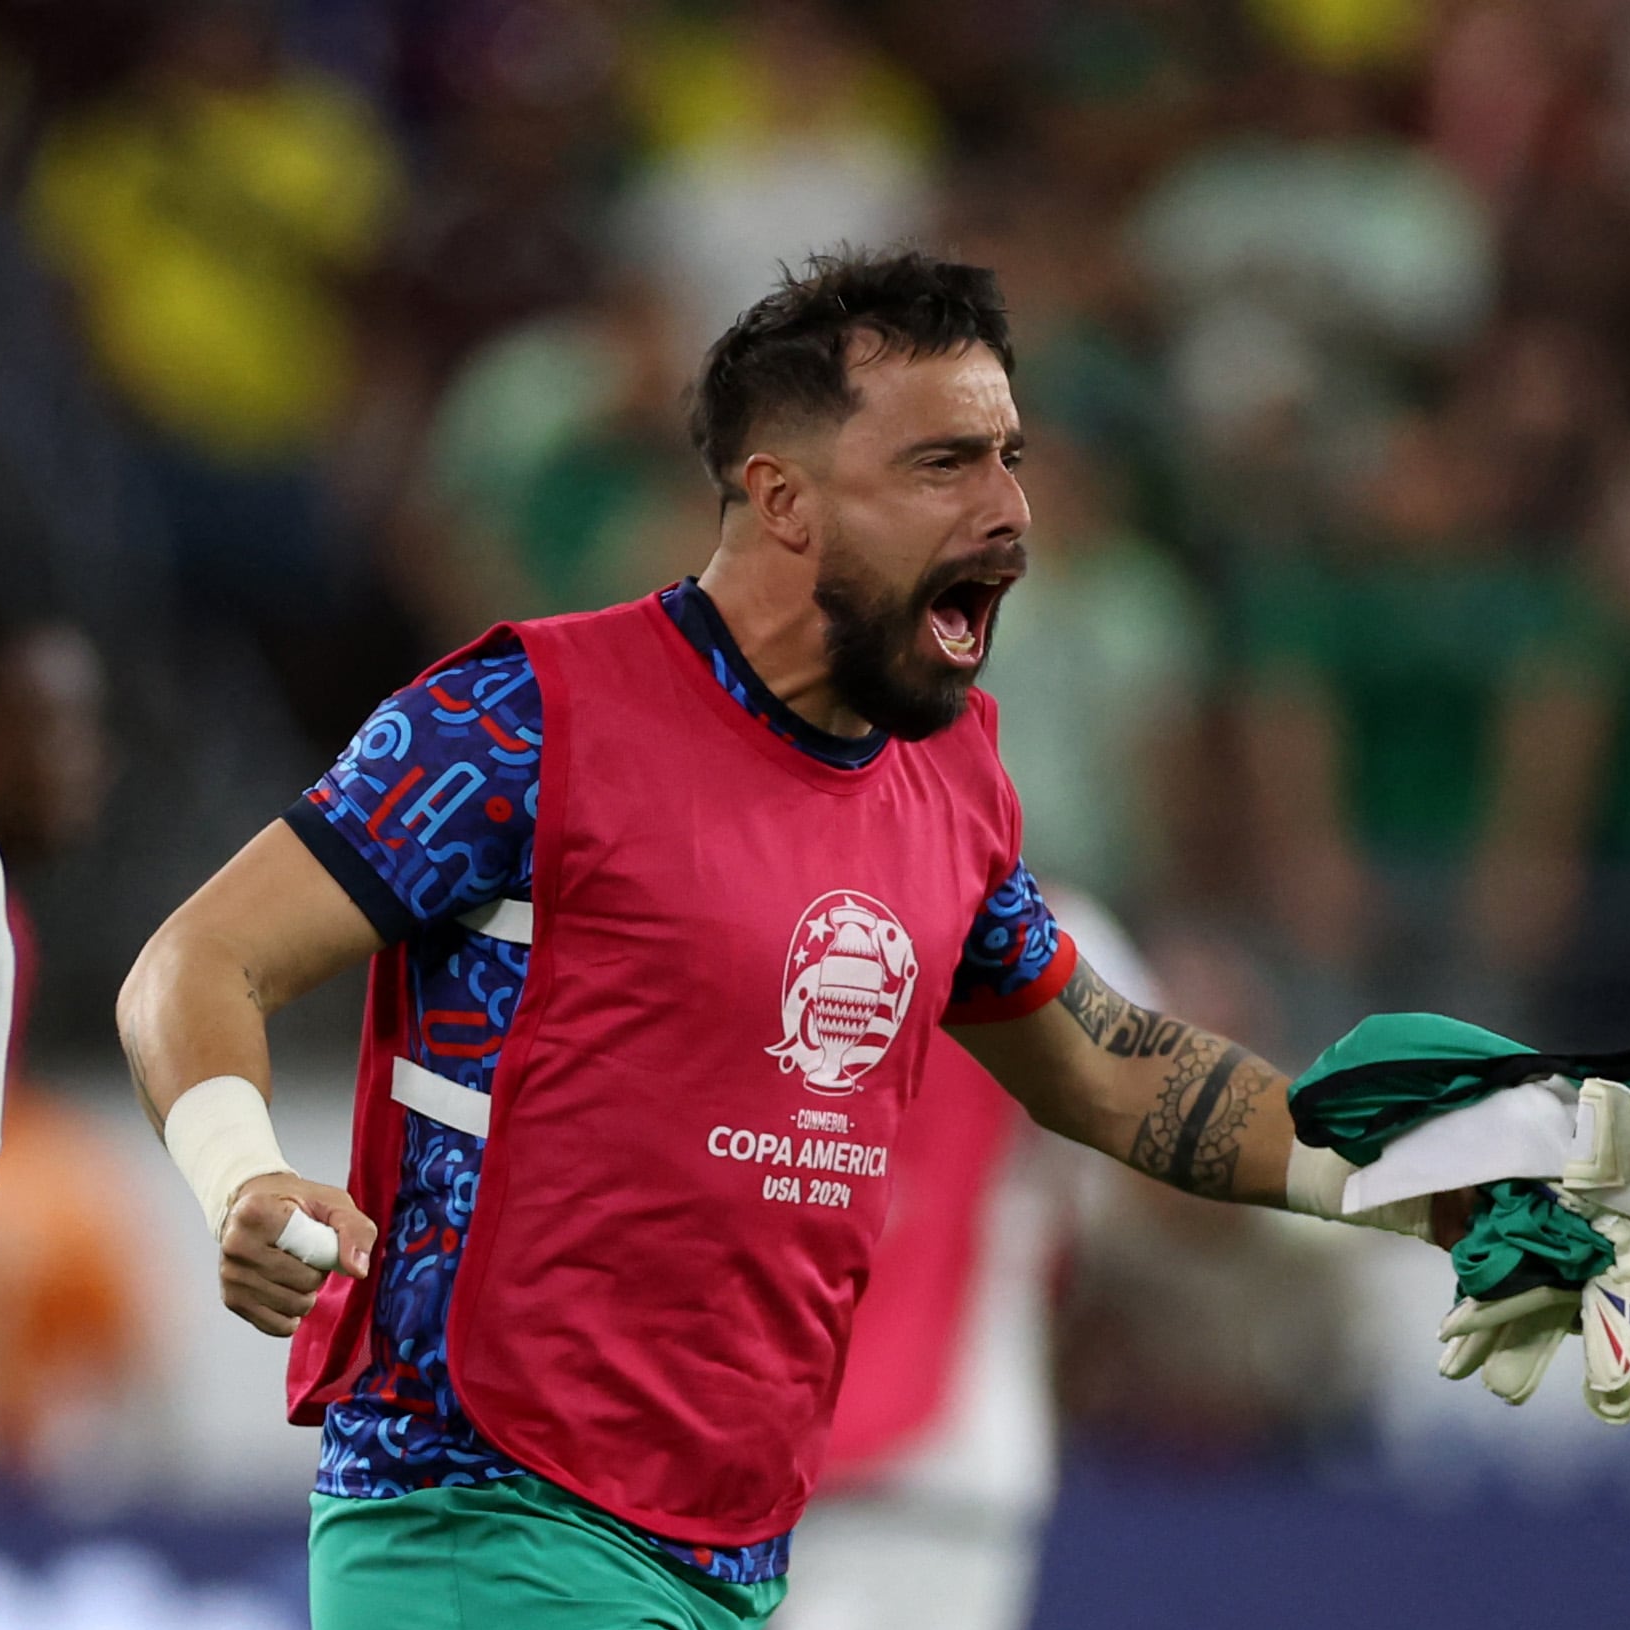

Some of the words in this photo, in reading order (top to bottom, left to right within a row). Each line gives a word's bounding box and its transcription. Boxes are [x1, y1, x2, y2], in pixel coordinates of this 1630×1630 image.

[707, 1125, 793, 1168] COPA
[795, 1137, 888, 1177] AMERICA
[762, 1174, 801, 1205] USA
[806, 1178, 852, 1209] 2024
